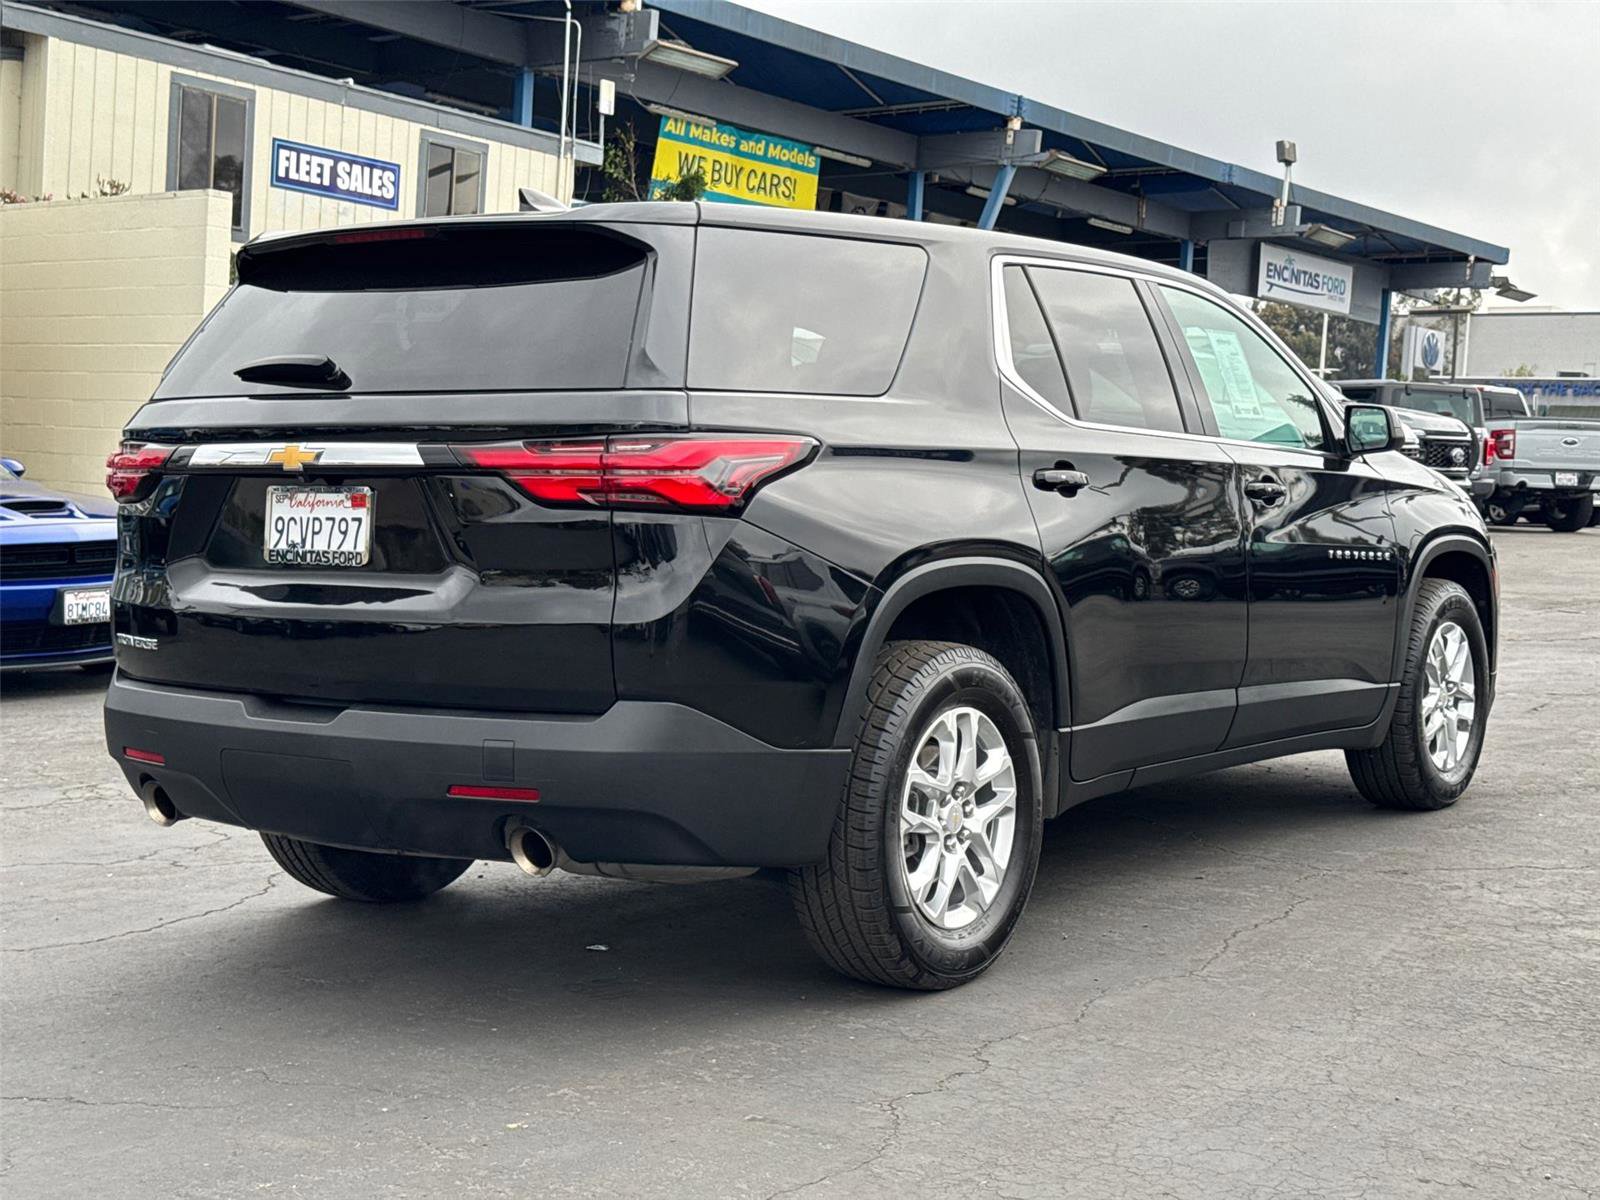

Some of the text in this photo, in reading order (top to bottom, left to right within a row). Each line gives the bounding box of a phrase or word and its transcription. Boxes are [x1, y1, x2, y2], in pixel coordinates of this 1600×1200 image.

[664, 117, 817, 168] All Makes and Models
[278, 148, 395, 200] FLEET SALES
[678, 151, 798, 202] WE BUY CARS!
[1266, 262, 1346, 295] ENCINITAS FORD
[289, 490, 345, 513] California
[273, 516, 363, 551] 9CVP797
[268, 548, 363, 566] ENCINITAS FORD
